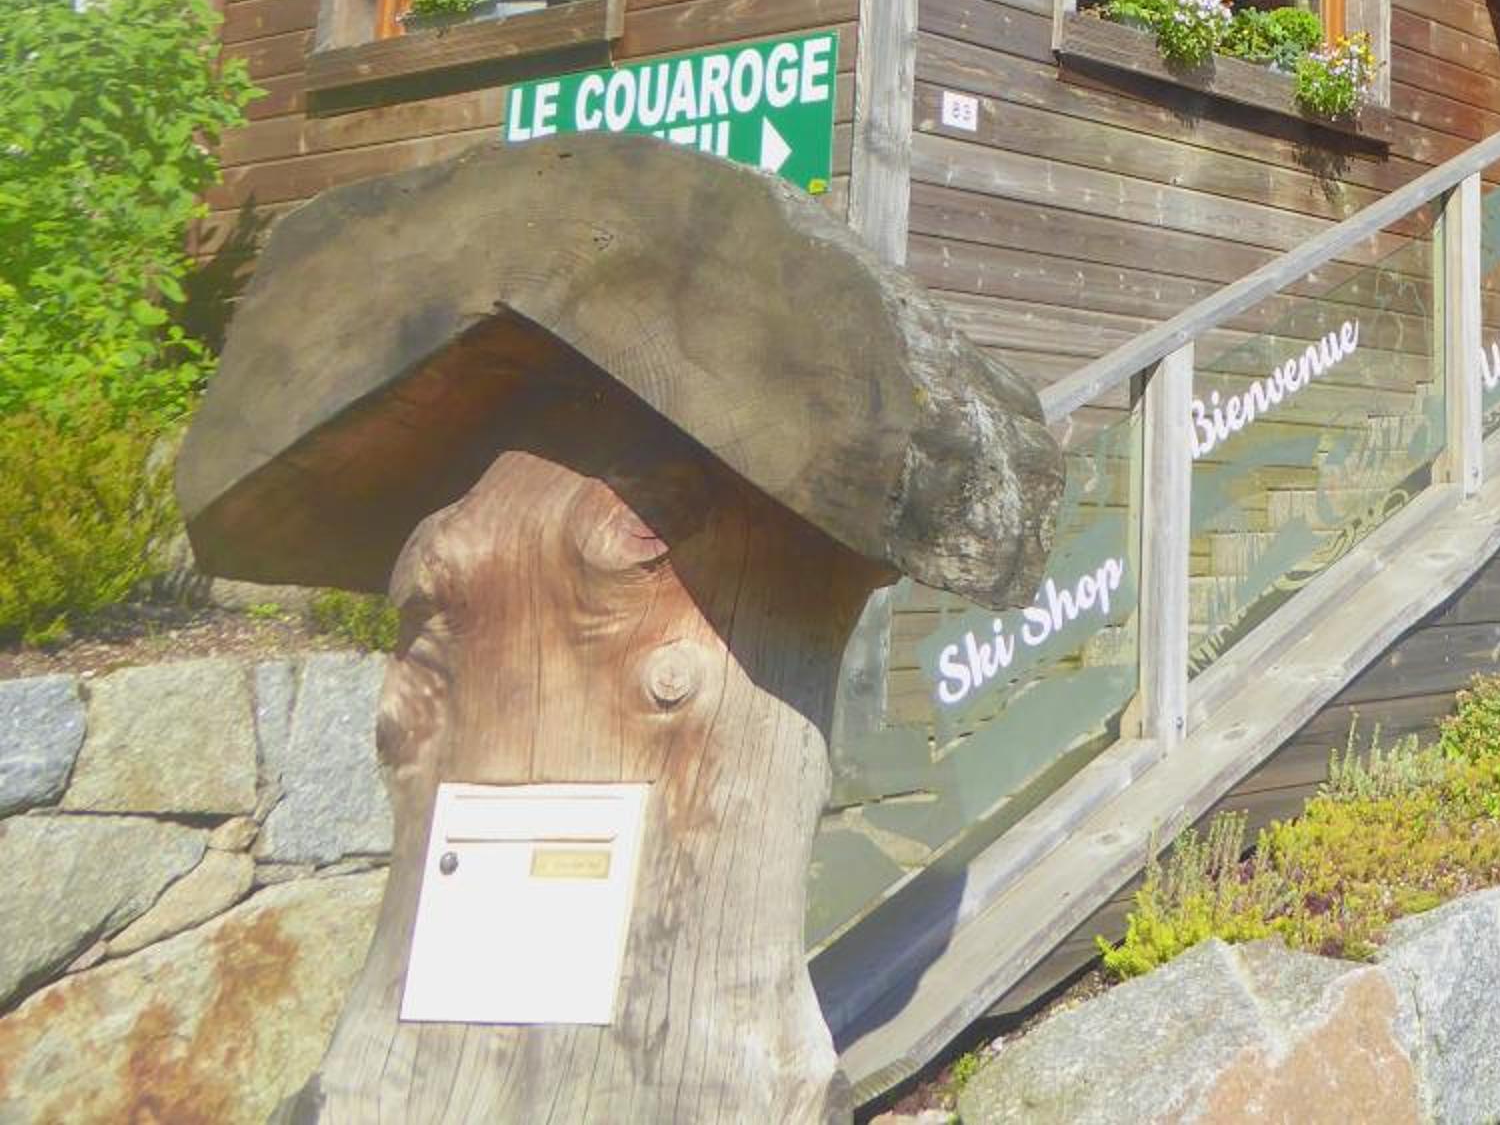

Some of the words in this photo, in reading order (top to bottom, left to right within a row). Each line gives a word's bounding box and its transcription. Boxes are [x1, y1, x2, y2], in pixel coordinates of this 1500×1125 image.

[507, 81, 560, 142] LE
[575, 37, 832, 132] COUAROGE
[1190, 315, 1359, 459] Bienvenue
[938, 618, 1015, 704] Ski
[1022, 557, 1124, 646] Shop
